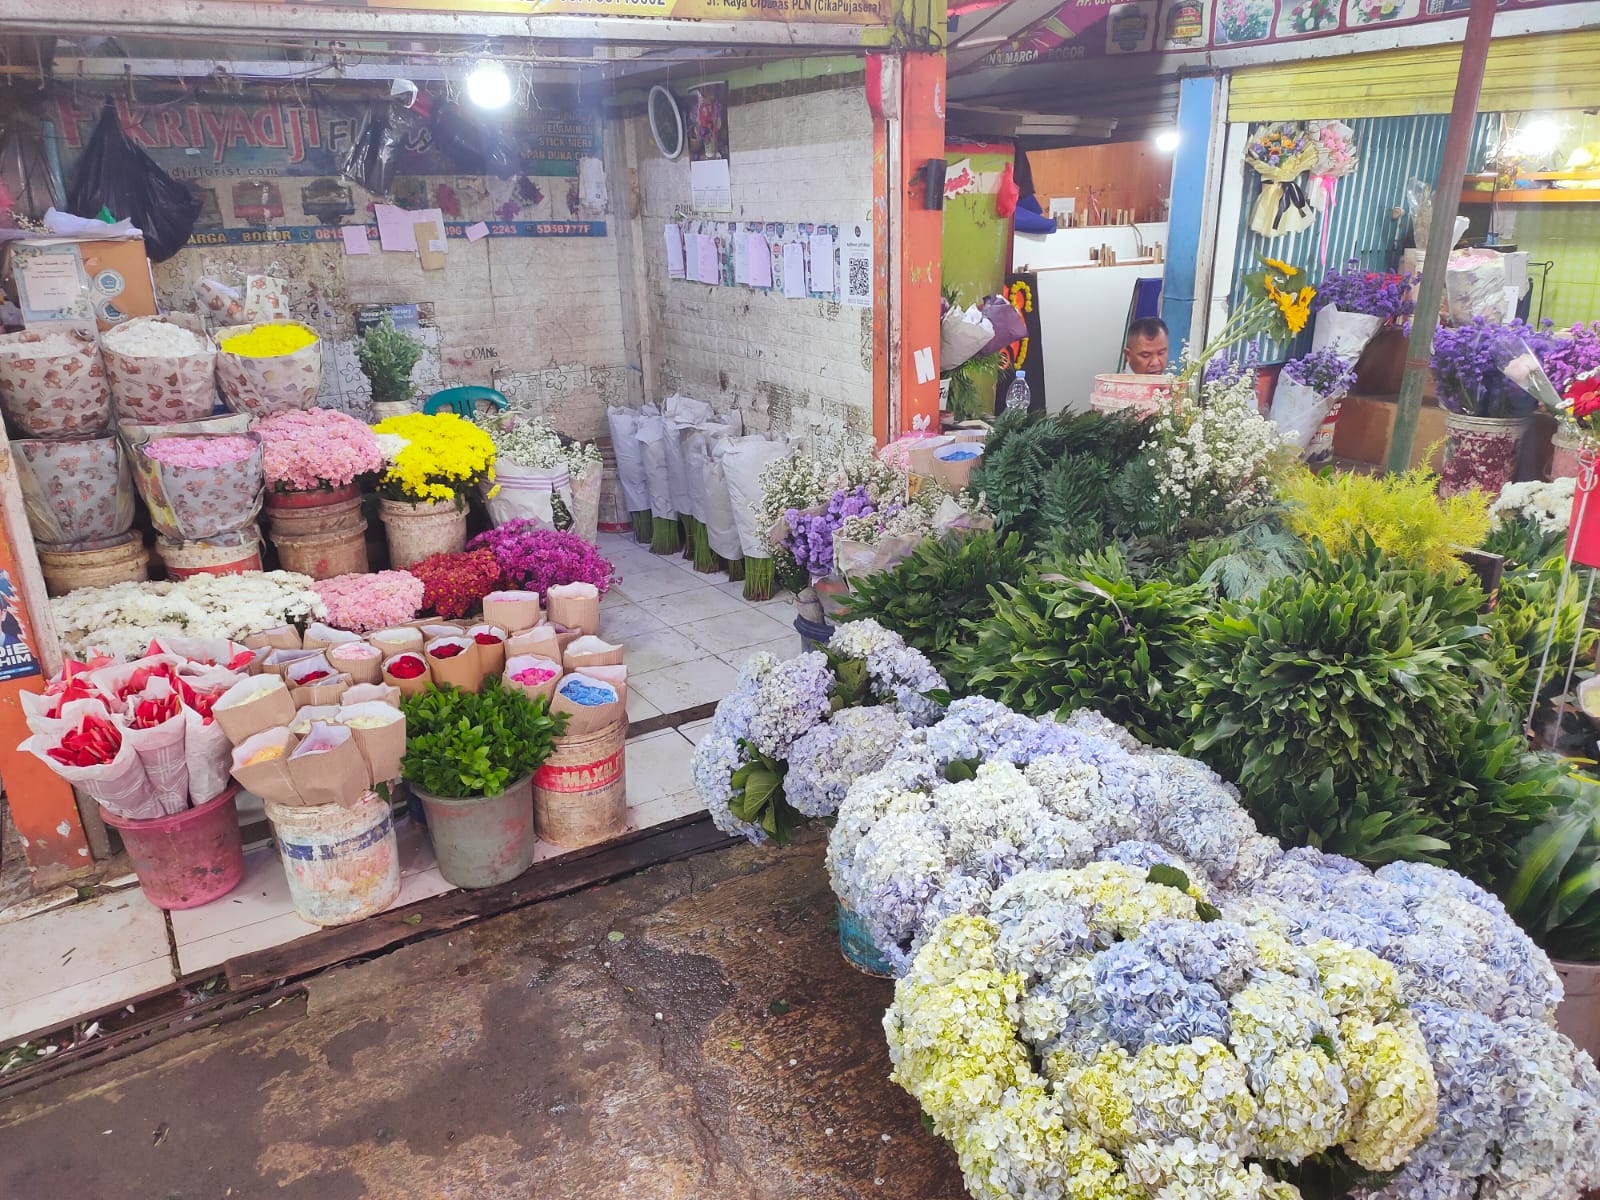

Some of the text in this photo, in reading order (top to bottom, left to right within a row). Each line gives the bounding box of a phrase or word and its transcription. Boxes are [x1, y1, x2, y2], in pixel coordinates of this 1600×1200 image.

[792, 0, 811, 10] PLN
[1006, 49, 1040, 63] MARGA
[183, 232, 228, 245] ARGA
